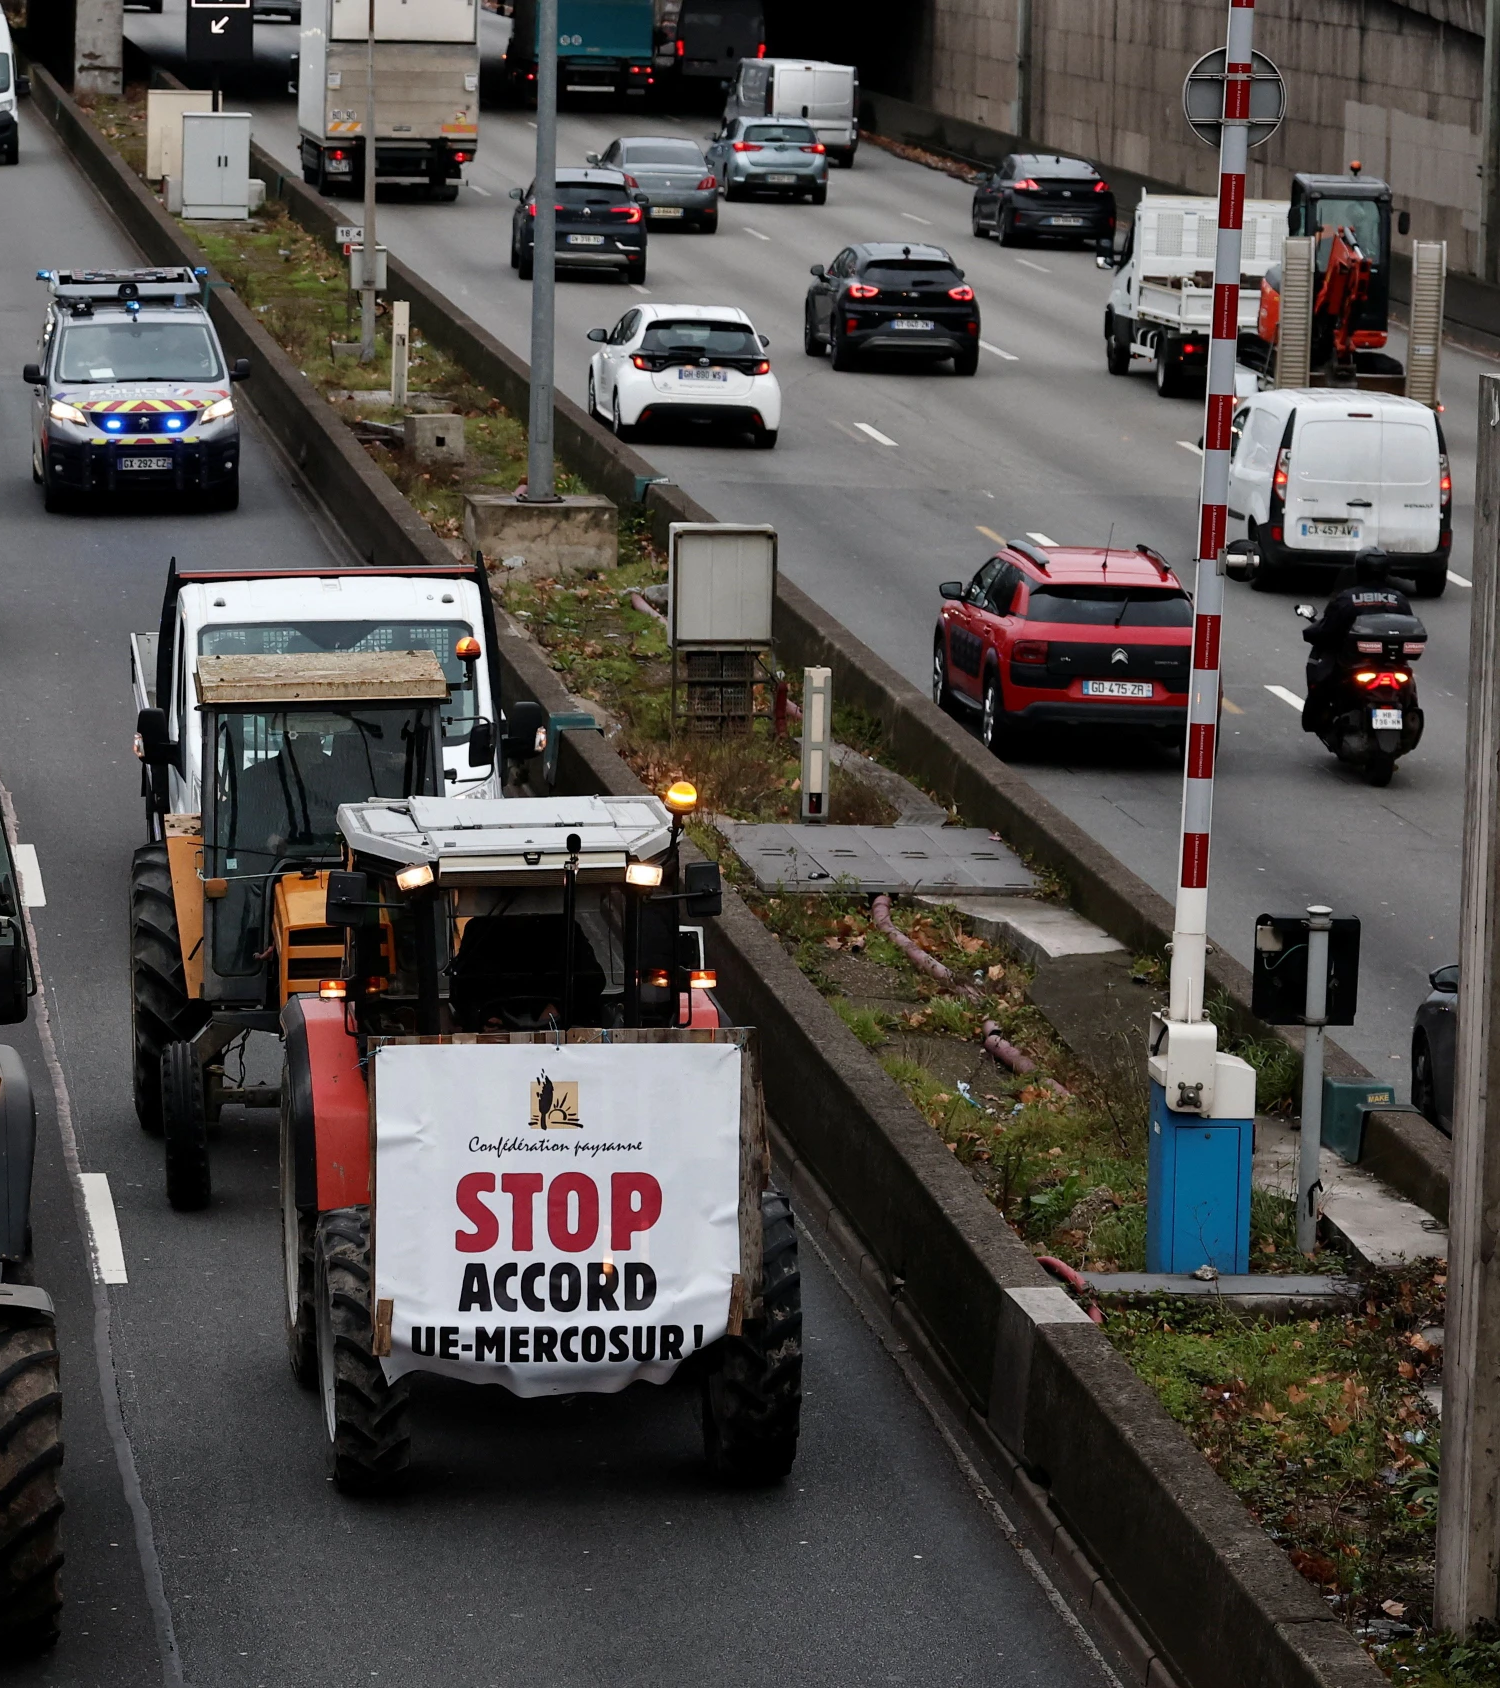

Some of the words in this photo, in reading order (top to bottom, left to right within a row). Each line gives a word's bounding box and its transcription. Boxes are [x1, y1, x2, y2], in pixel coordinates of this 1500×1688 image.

[89, 387, 169, 395] POLICE
[123, 458, 167, 469] GX-292-CZ
[1308, 525, 1353, 536] CX-457-AV
[468, 1136, 570, 1158] Confédération
[573, 1140, 644, 1157] paysanne
[455, 1171, 663, 1253] STOP
[458, 1262, 657, 1312] ACCORD
